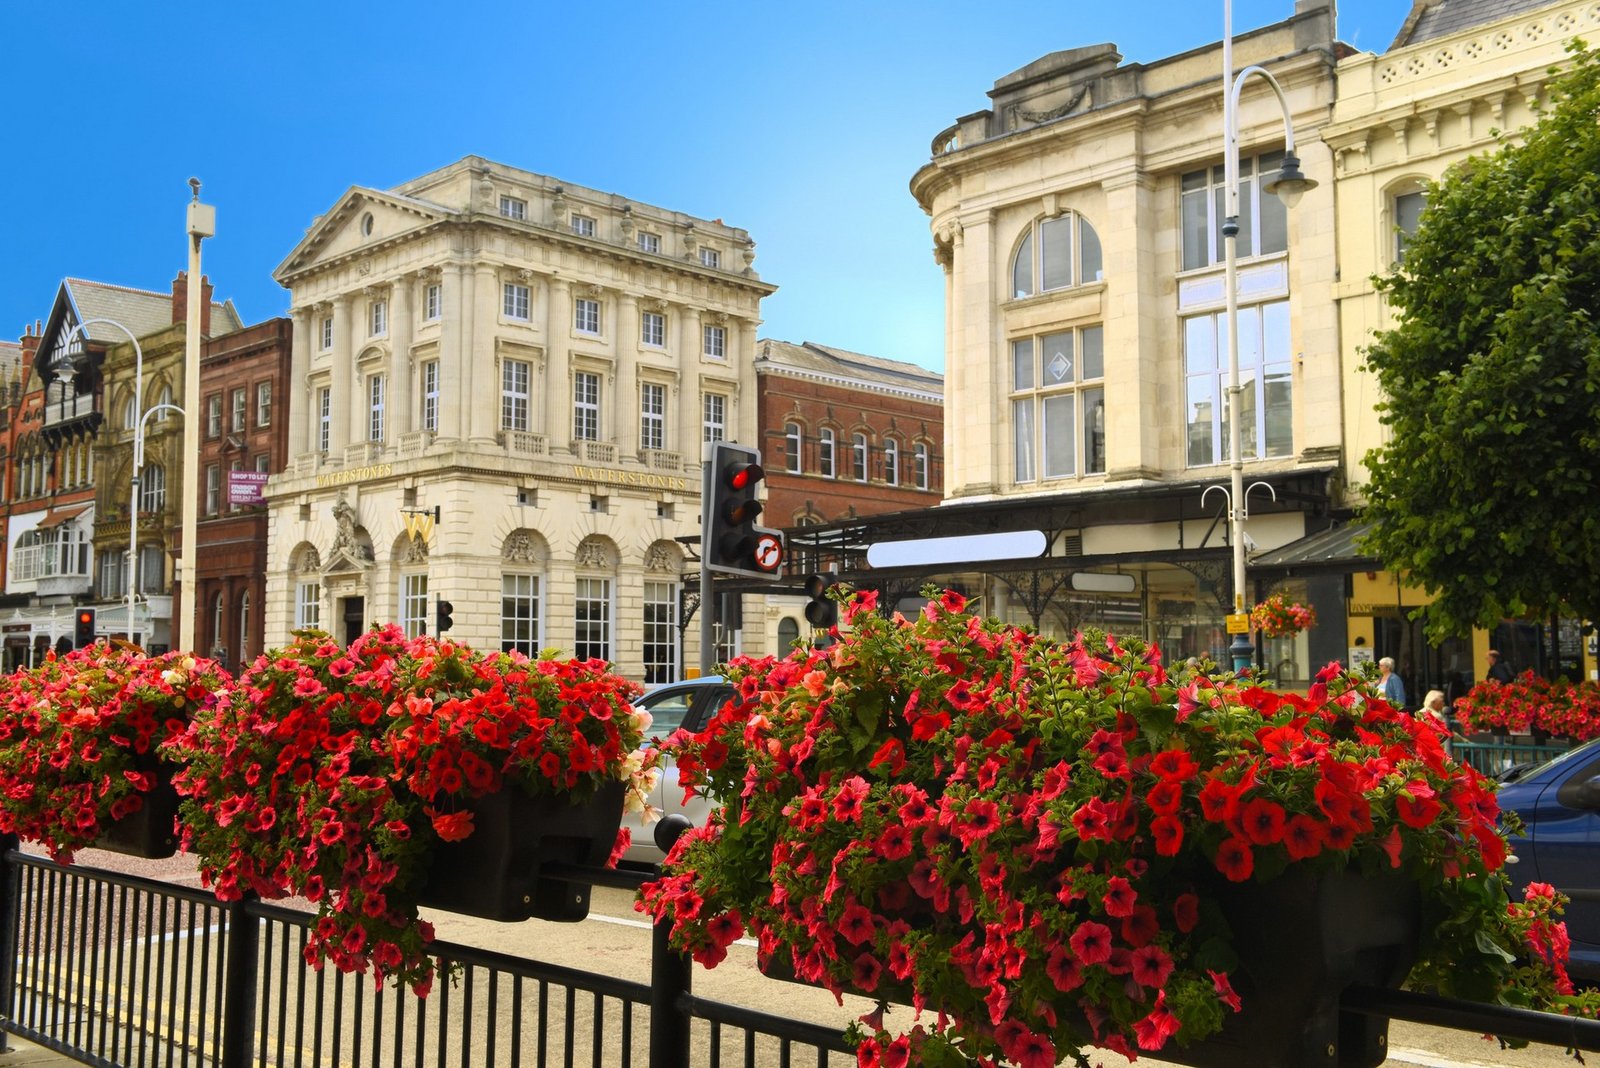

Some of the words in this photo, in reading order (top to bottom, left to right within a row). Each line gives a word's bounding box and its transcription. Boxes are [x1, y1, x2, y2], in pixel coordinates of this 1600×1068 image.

[316, 463, 392, 487] WATERSTONES
[573, 466, 686, 489] WATERSTONES
[402, 513, 434, 544] W
